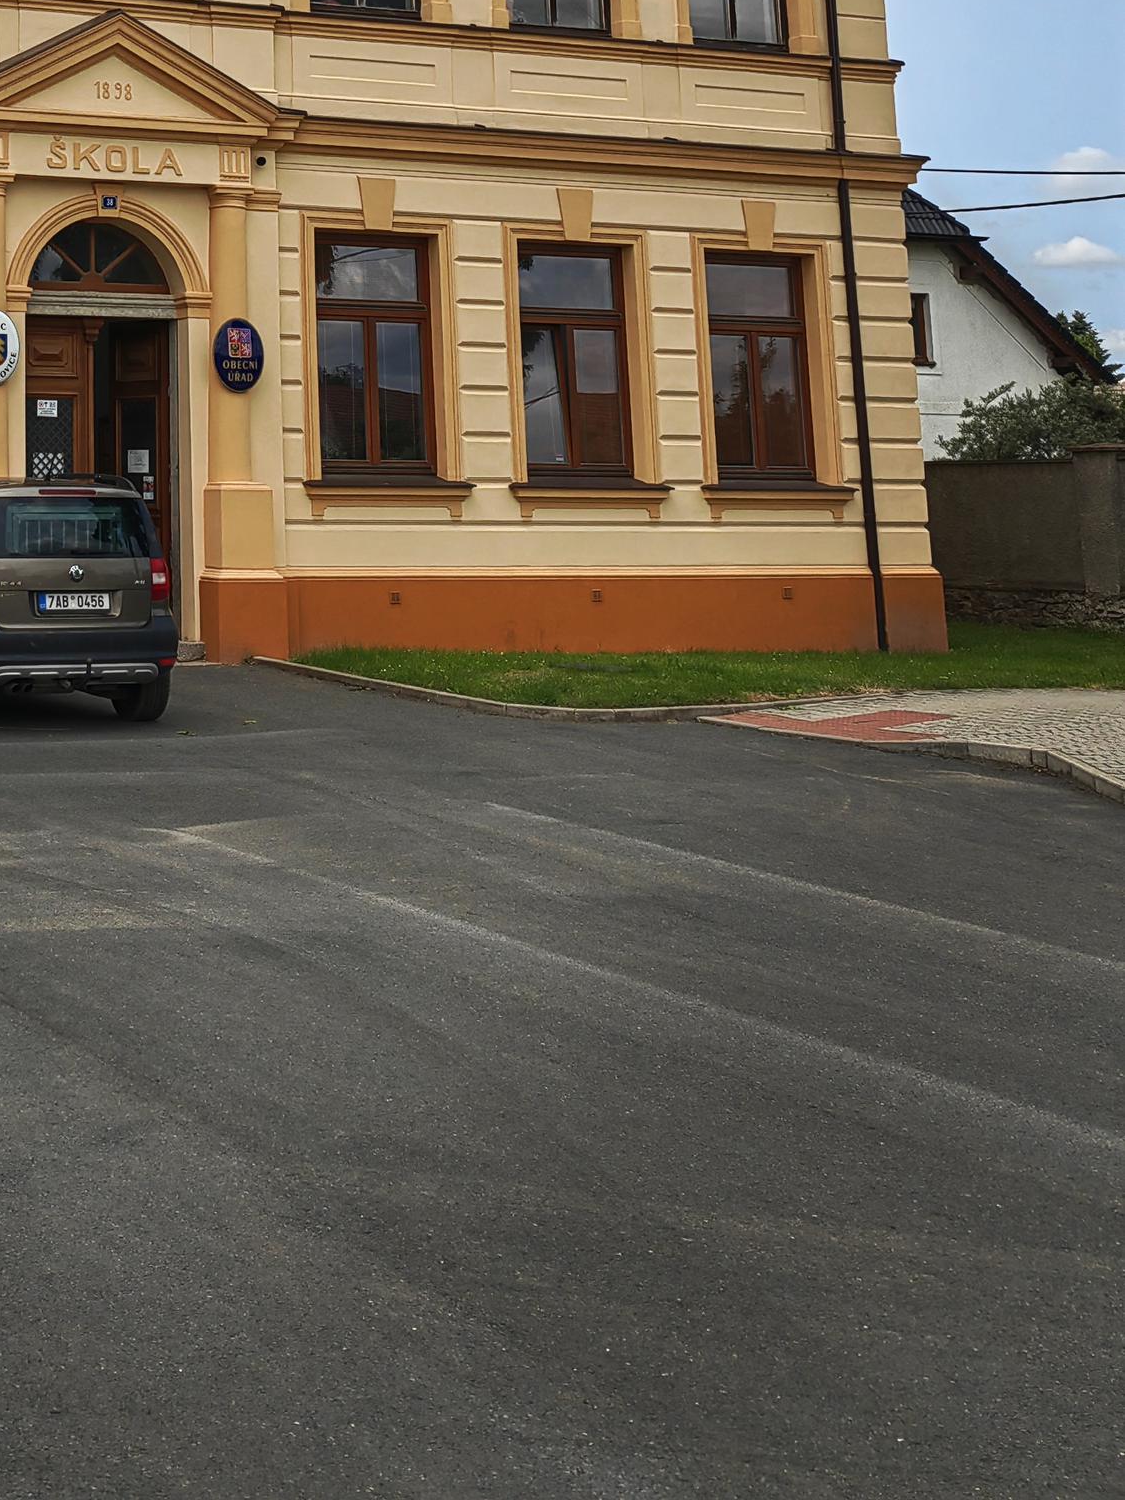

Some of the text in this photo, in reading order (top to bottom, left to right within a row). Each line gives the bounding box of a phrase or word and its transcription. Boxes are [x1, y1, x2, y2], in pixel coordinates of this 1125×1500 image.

[94, 81, 132, 101] 1898
[46, 134, 183, 177] ŠKOLA
[222, 359, 258, 370] OBECNÍ
[228, 370, 254, 382] ÚŘAD
[48, 595, 105, 608] 7AB 0456
